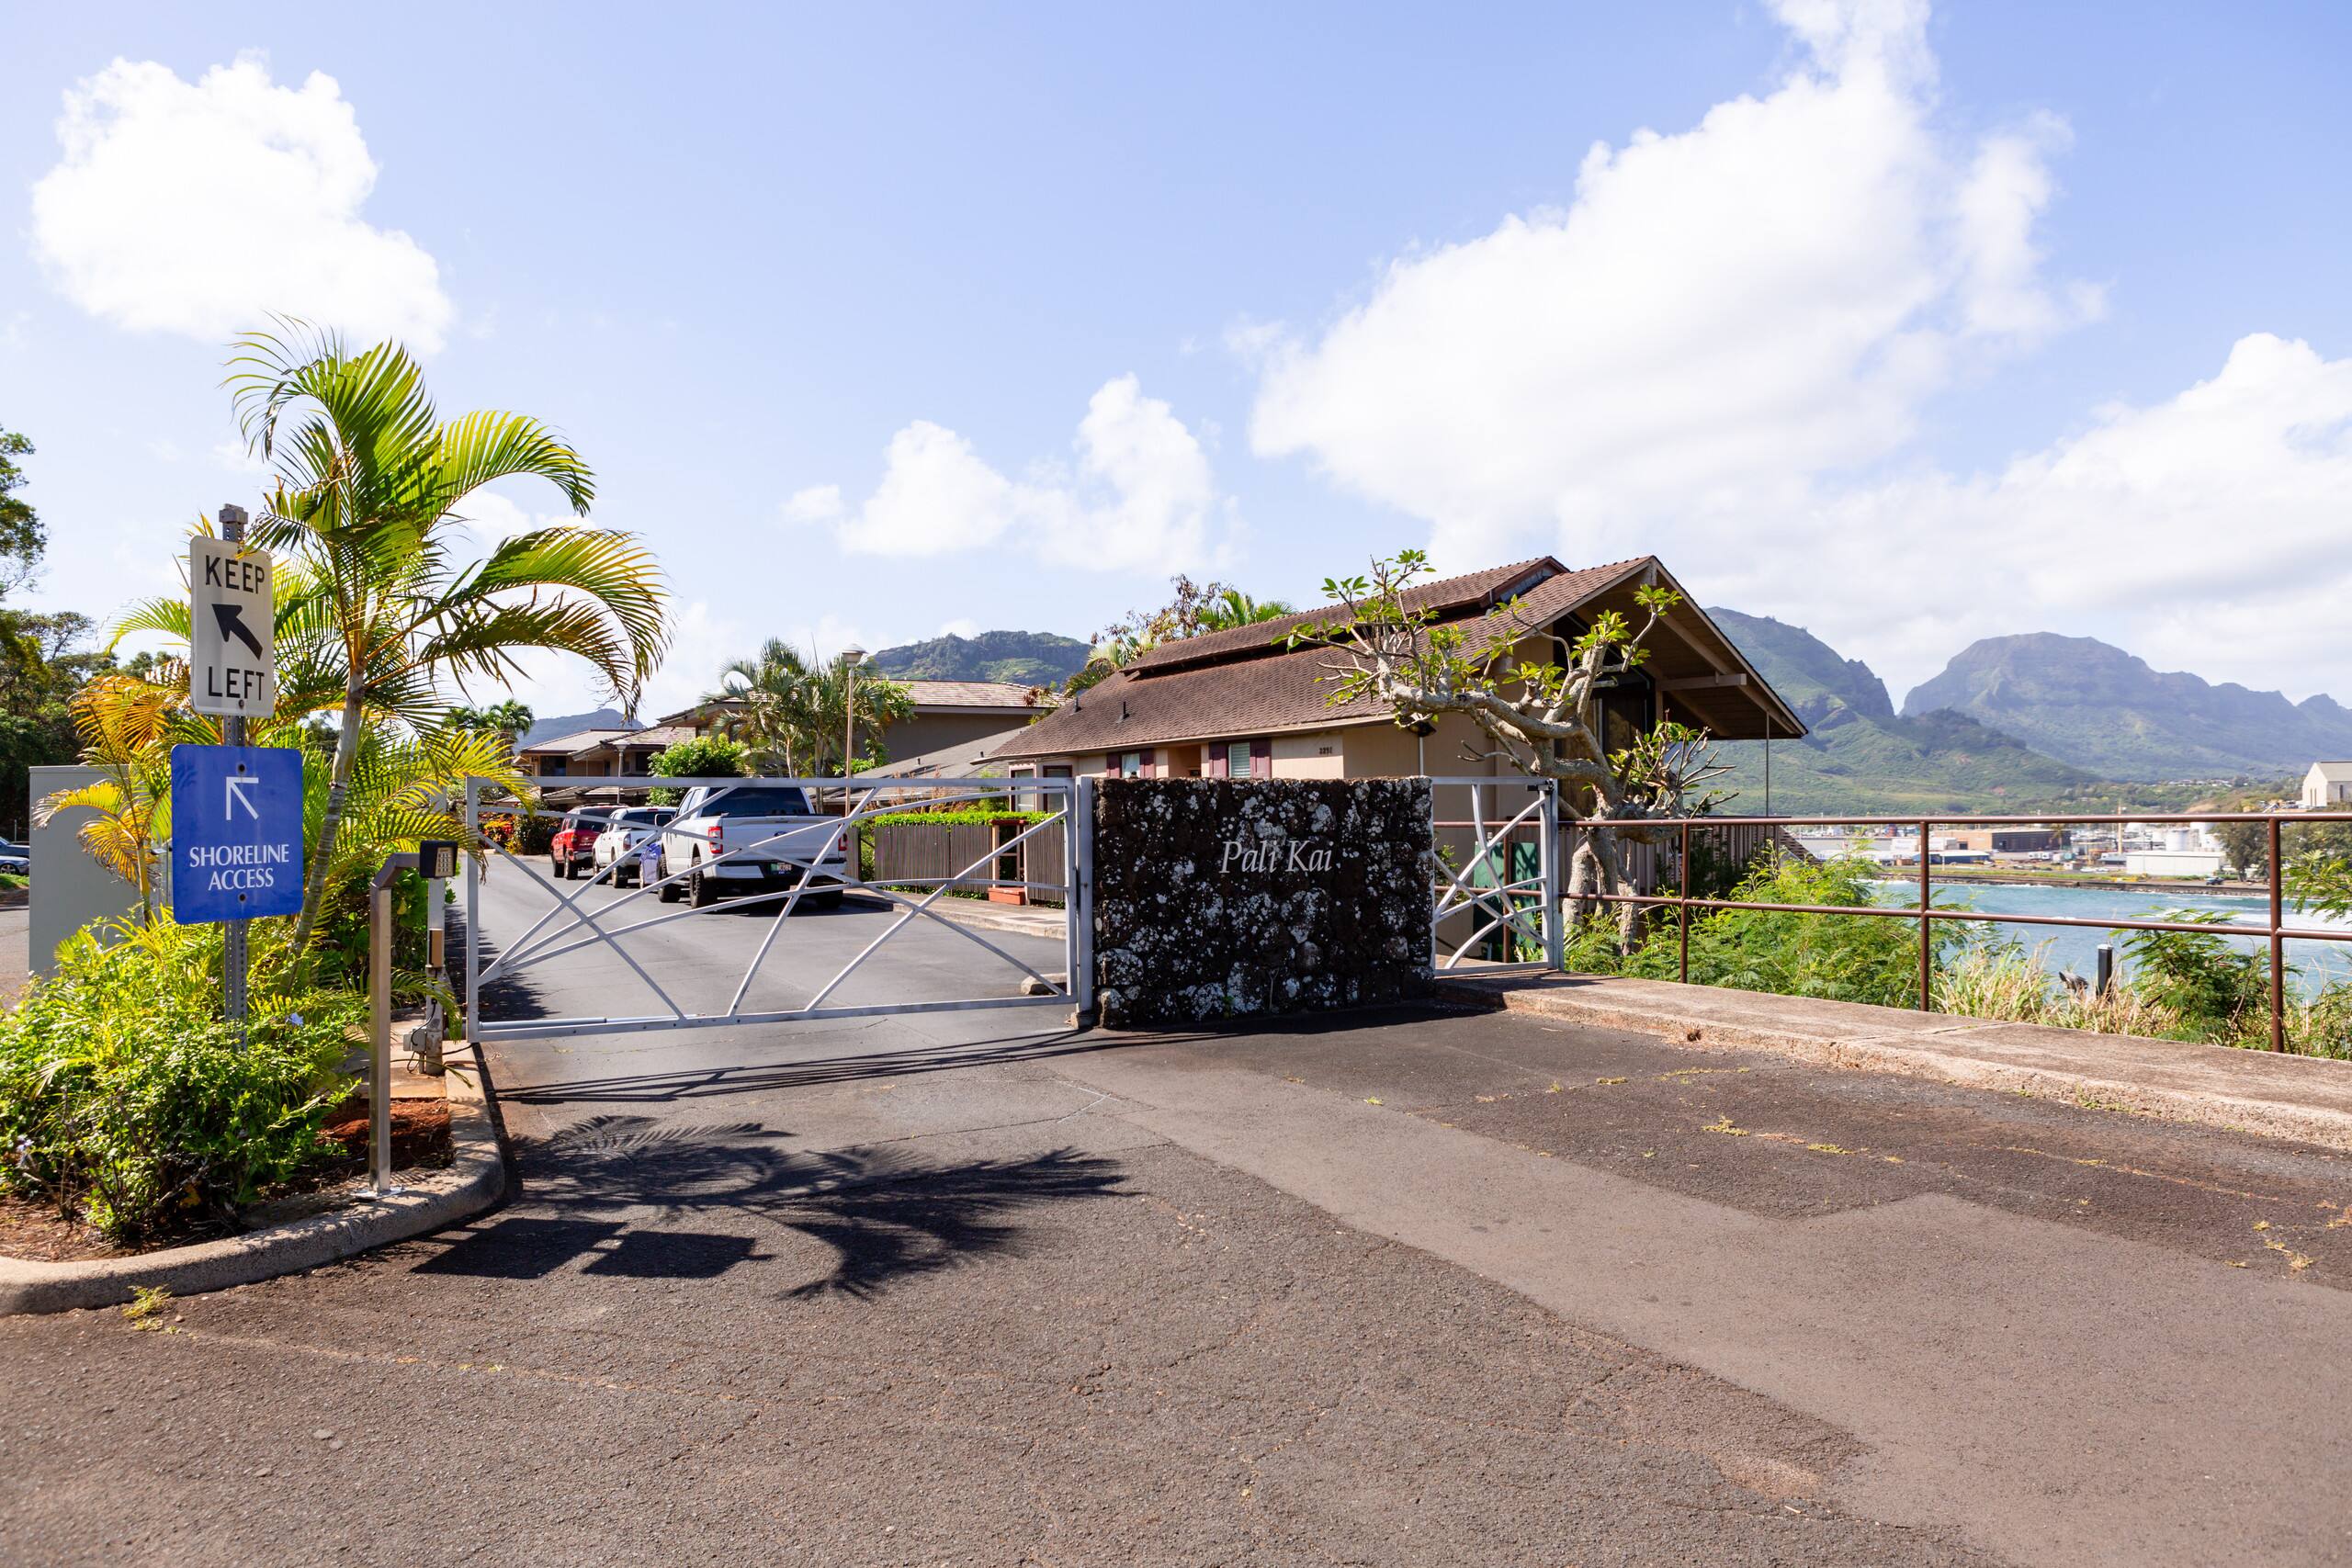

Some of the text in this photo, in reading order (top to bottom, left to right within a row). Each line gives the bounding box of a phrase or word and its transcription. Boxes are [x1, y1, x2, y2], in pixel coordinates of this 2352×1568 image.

[205, 555, 265, 594] KEEP
[208, 666, 265, 701] LEFT
[189, 844, 289, 868] SHORELINE
[1219, 840, 1333, 874] Pali Kai
[208, 867, 275, 891] ACCESS
